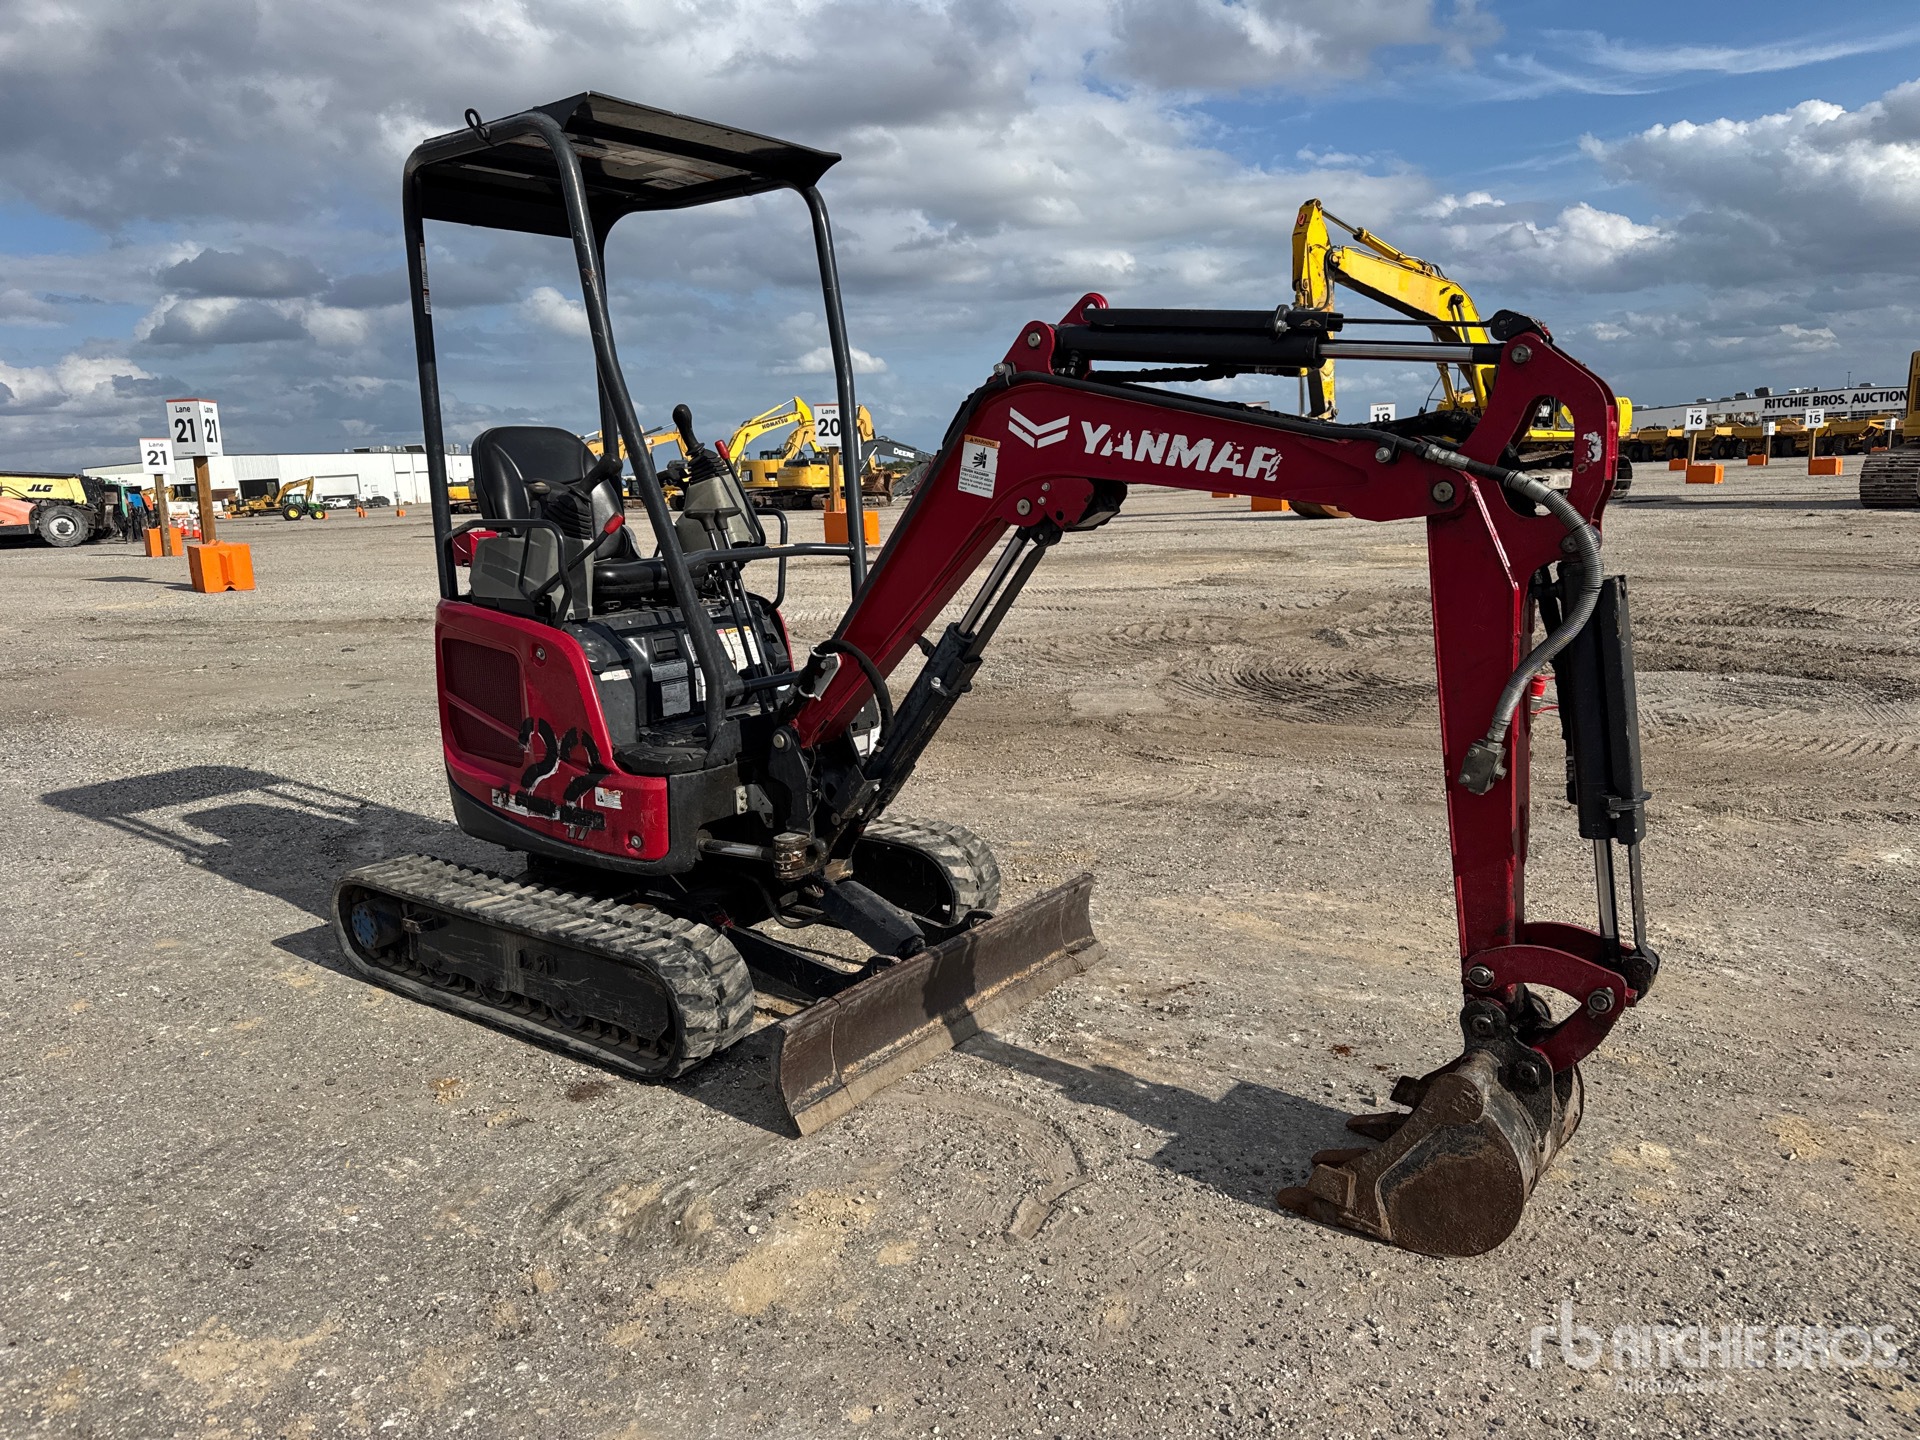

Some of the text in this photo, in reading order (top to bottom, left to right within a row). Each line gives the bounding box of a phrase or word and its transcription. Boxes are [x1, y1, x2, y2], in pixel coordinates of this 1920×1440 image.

[1764, 396, 1809, 409] RITCHIE
[1812, 394, 1848, 406] BROS.
[174, 405, 191, 413] Lane
[203, 405, 213, 414] Lane
[761, 417, 789, 430] KOMATSU
[1689, 414, 1703, 425] 16
[1808, 414, 1821, 424] 15
[174, 418, 196, 443] 21
[204, 418, 218, 443] 21
[818, 418, 840, 437] 20
[974, 439, 995, 447] WARNING
[893, 447, 915, 459] DEERE
[1081, 420, 1284, 482] YANMAR
[146, 450, 168, 466] 21
[27, 484, 53, 492] JLG
